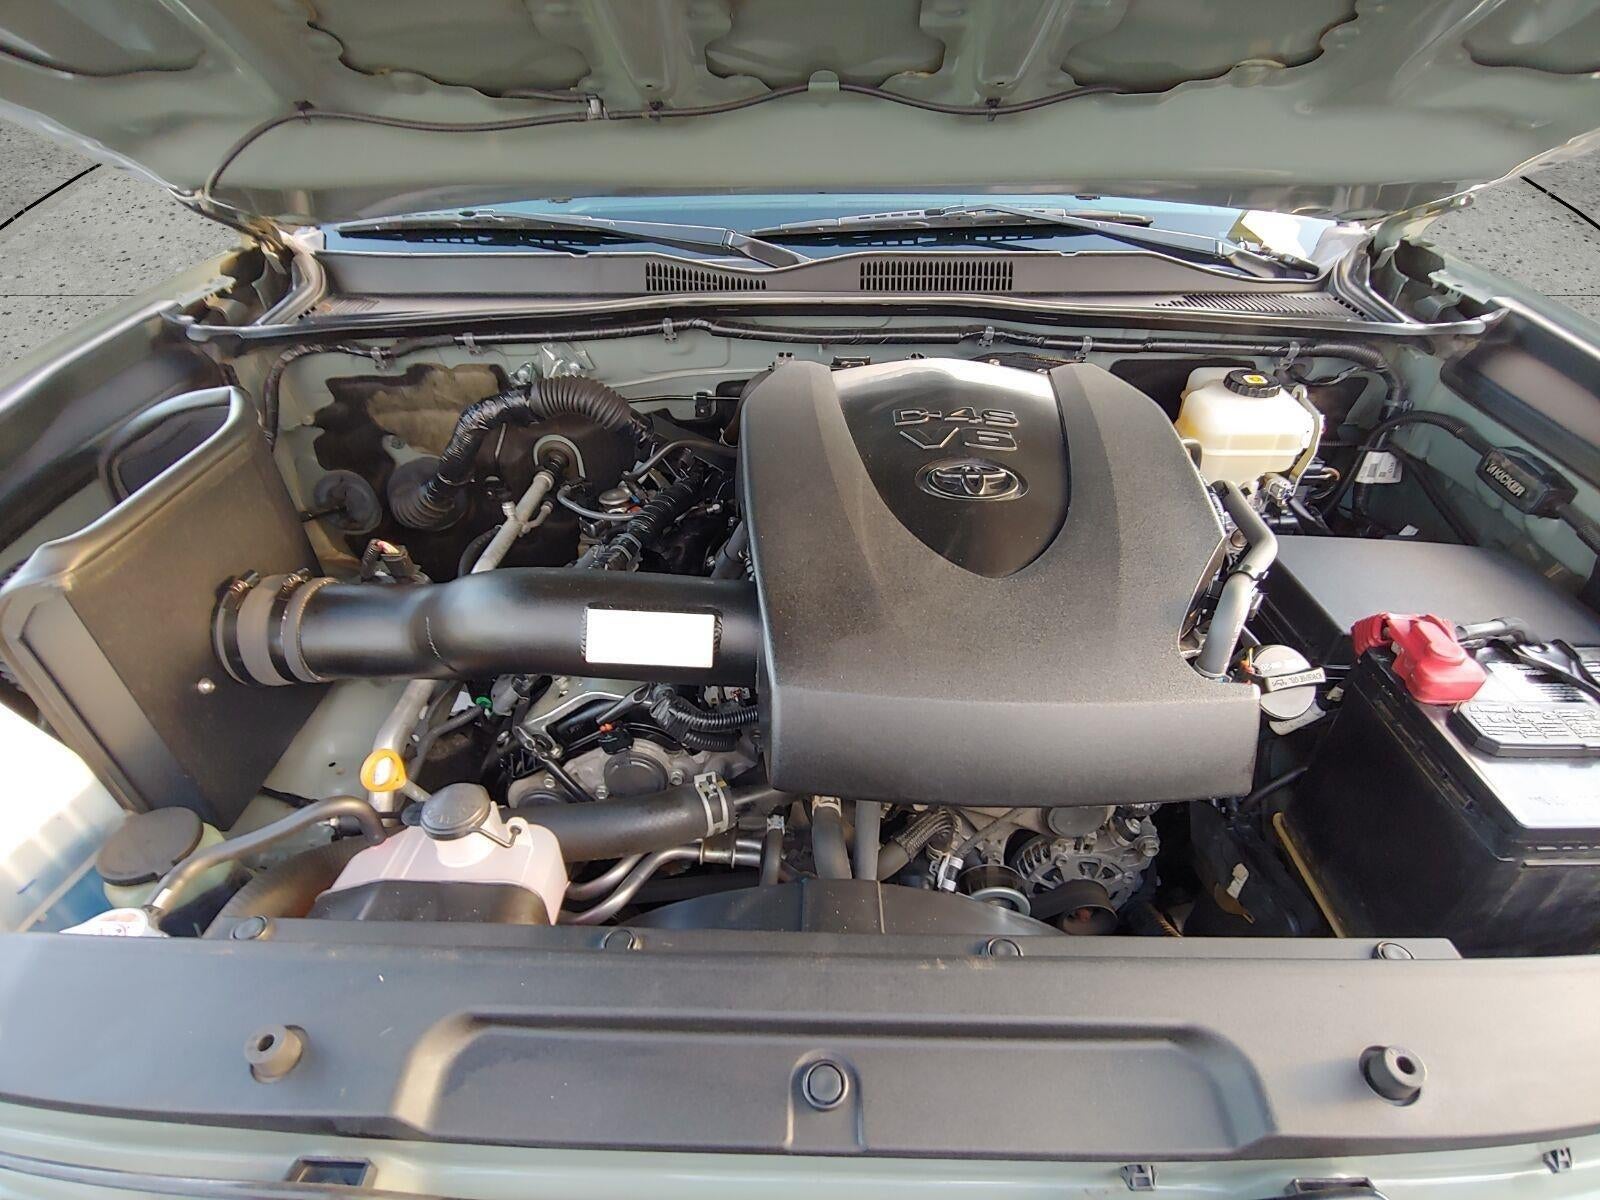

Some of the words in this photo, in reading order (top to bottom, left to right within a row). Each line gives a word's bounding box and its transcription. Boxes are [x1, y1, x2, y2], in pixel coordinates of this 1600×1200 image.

[893, 407, 1019, 428] D-4S
[899, 426, 1018, 451] V6
[1491, 466, 1525, 497] KICKER
